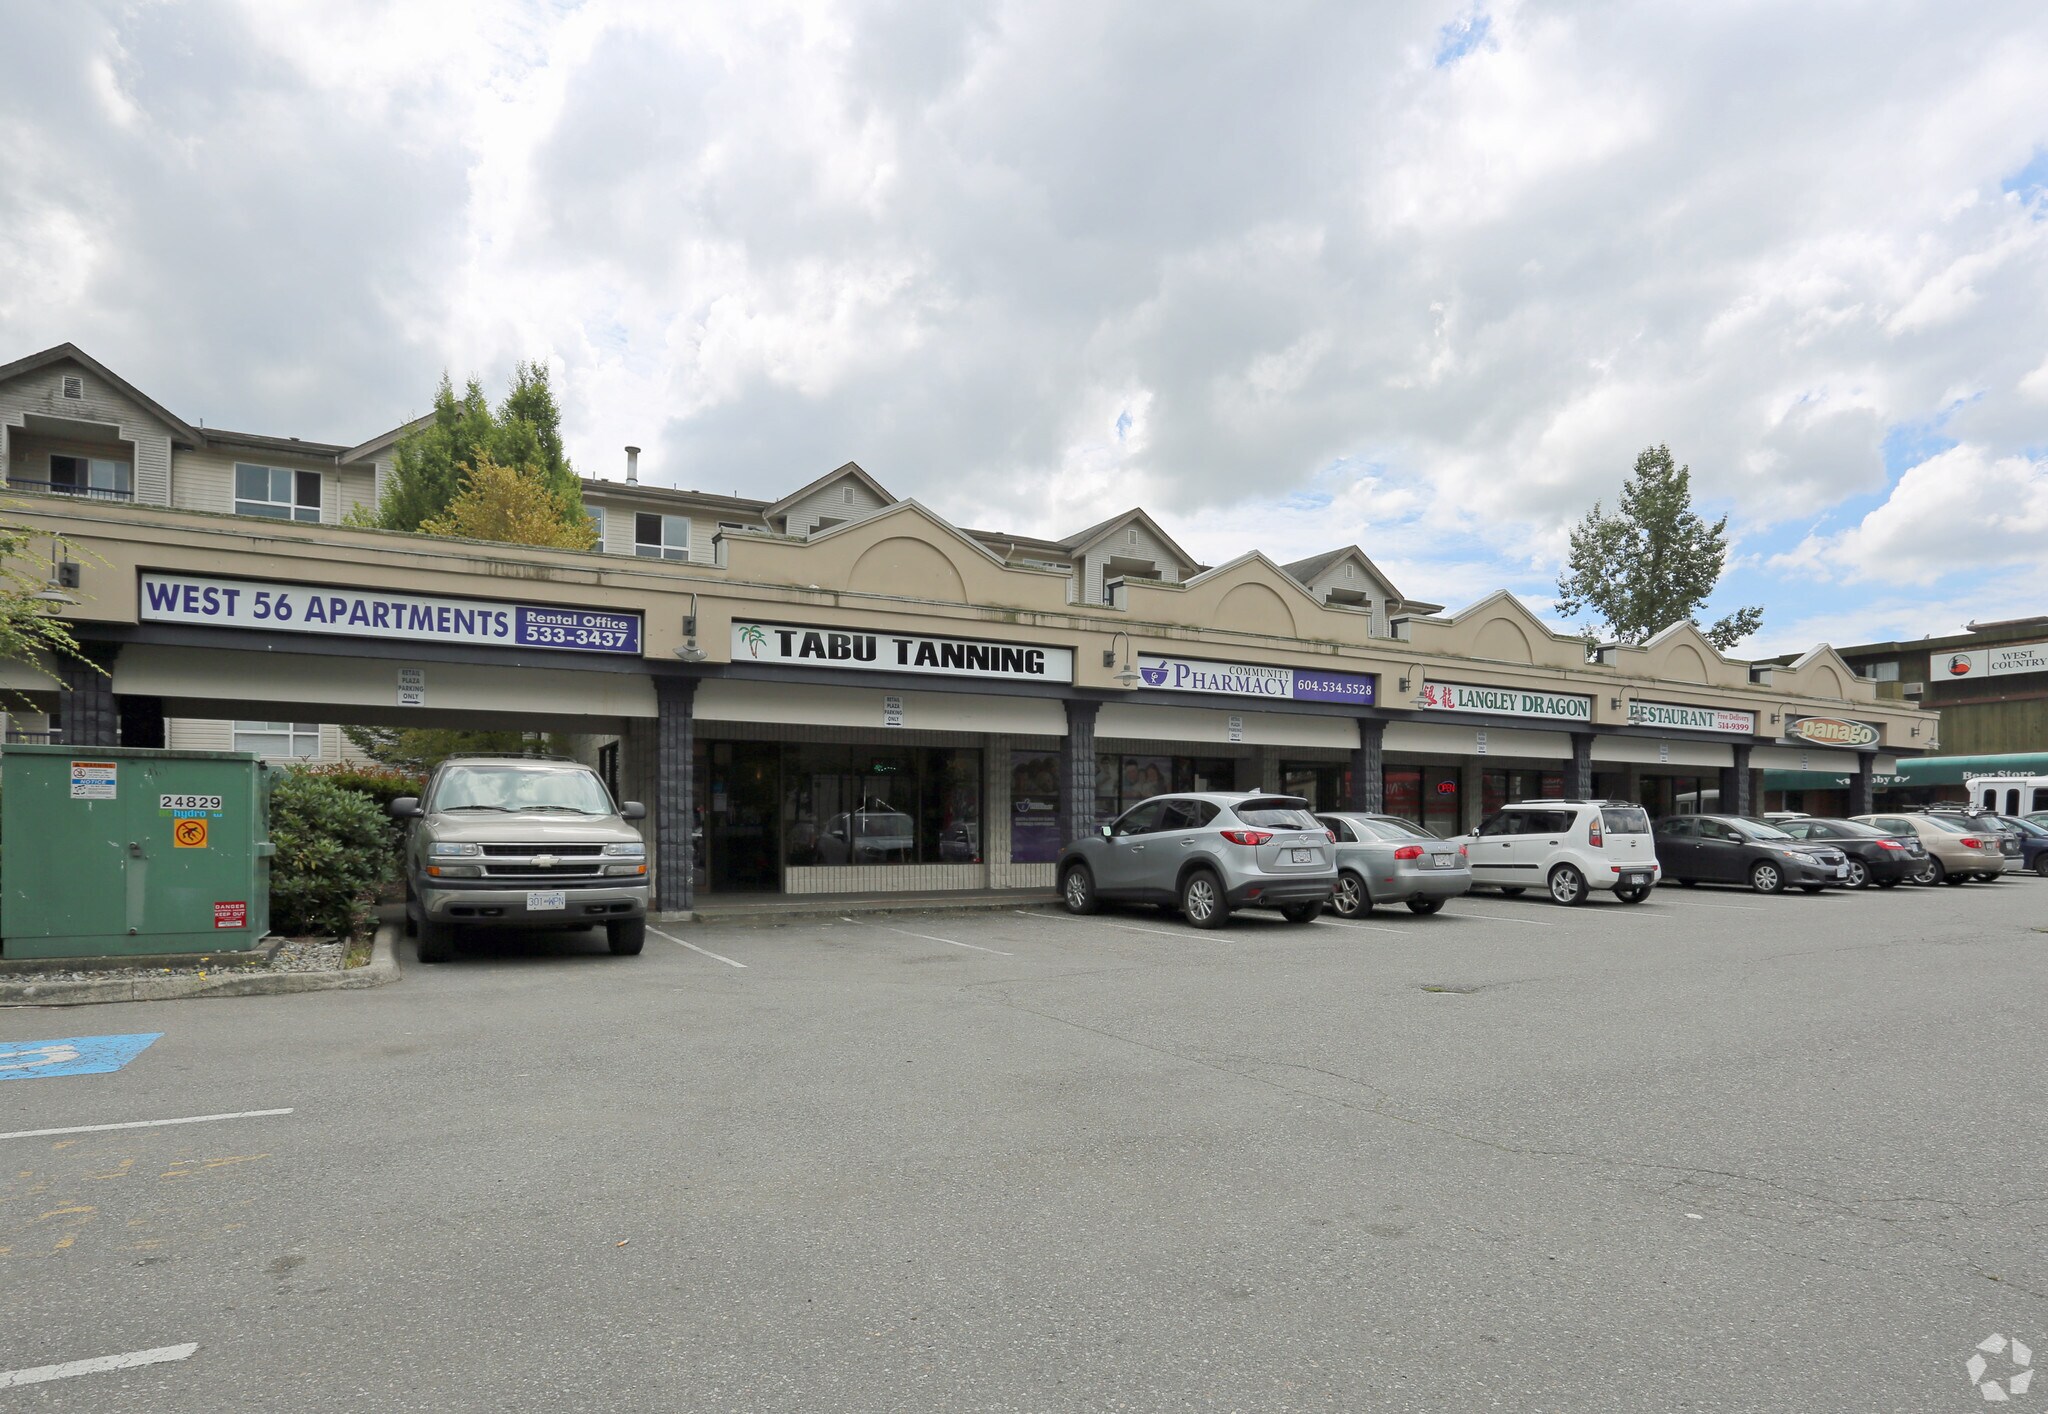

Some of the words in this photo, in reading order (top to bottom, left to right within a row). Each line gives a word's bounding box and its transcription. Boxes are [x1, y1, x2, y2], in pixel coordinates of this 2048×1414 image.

[146, 582, 240, 616] WEST
[253, 592, 292, 621] 56
[304, 596, 509, 638] APARTMENTS
[526, 611, 577, 625] Rental
[583, 616, 628, 630] Office
[526, 626, 628, 647] 533-3437
[775, 630, 877, 661] TABU
[892, 639, 1045, 674] TANNING
[2002, 650, 2034, 661] WEST
[1992, 658, 2047, 670] COUNTRY
[1174, 663, 1289, 696] PHARMACY
[1229, 666, 1291, 680] COMMUNITY
[1297, 679, 1372, 696] 604.534.5528
[1459, 689, 1517, 711] LANGLEY
[1522, 695, 1587, 717] DRAGON
[1717, 712, 1728, 720] Free
[1729, 713, 1749, 722] Delivery
[1717, 721, 1749, 731] 514-9399
[1802, 721, 1872, 744] panago
[1437, 783, 1455, 793] OPEN
[162, 796, 221, 809] 24829
[173, 809, 206, 819] hydro
[528, 897, 543, 906] 301
